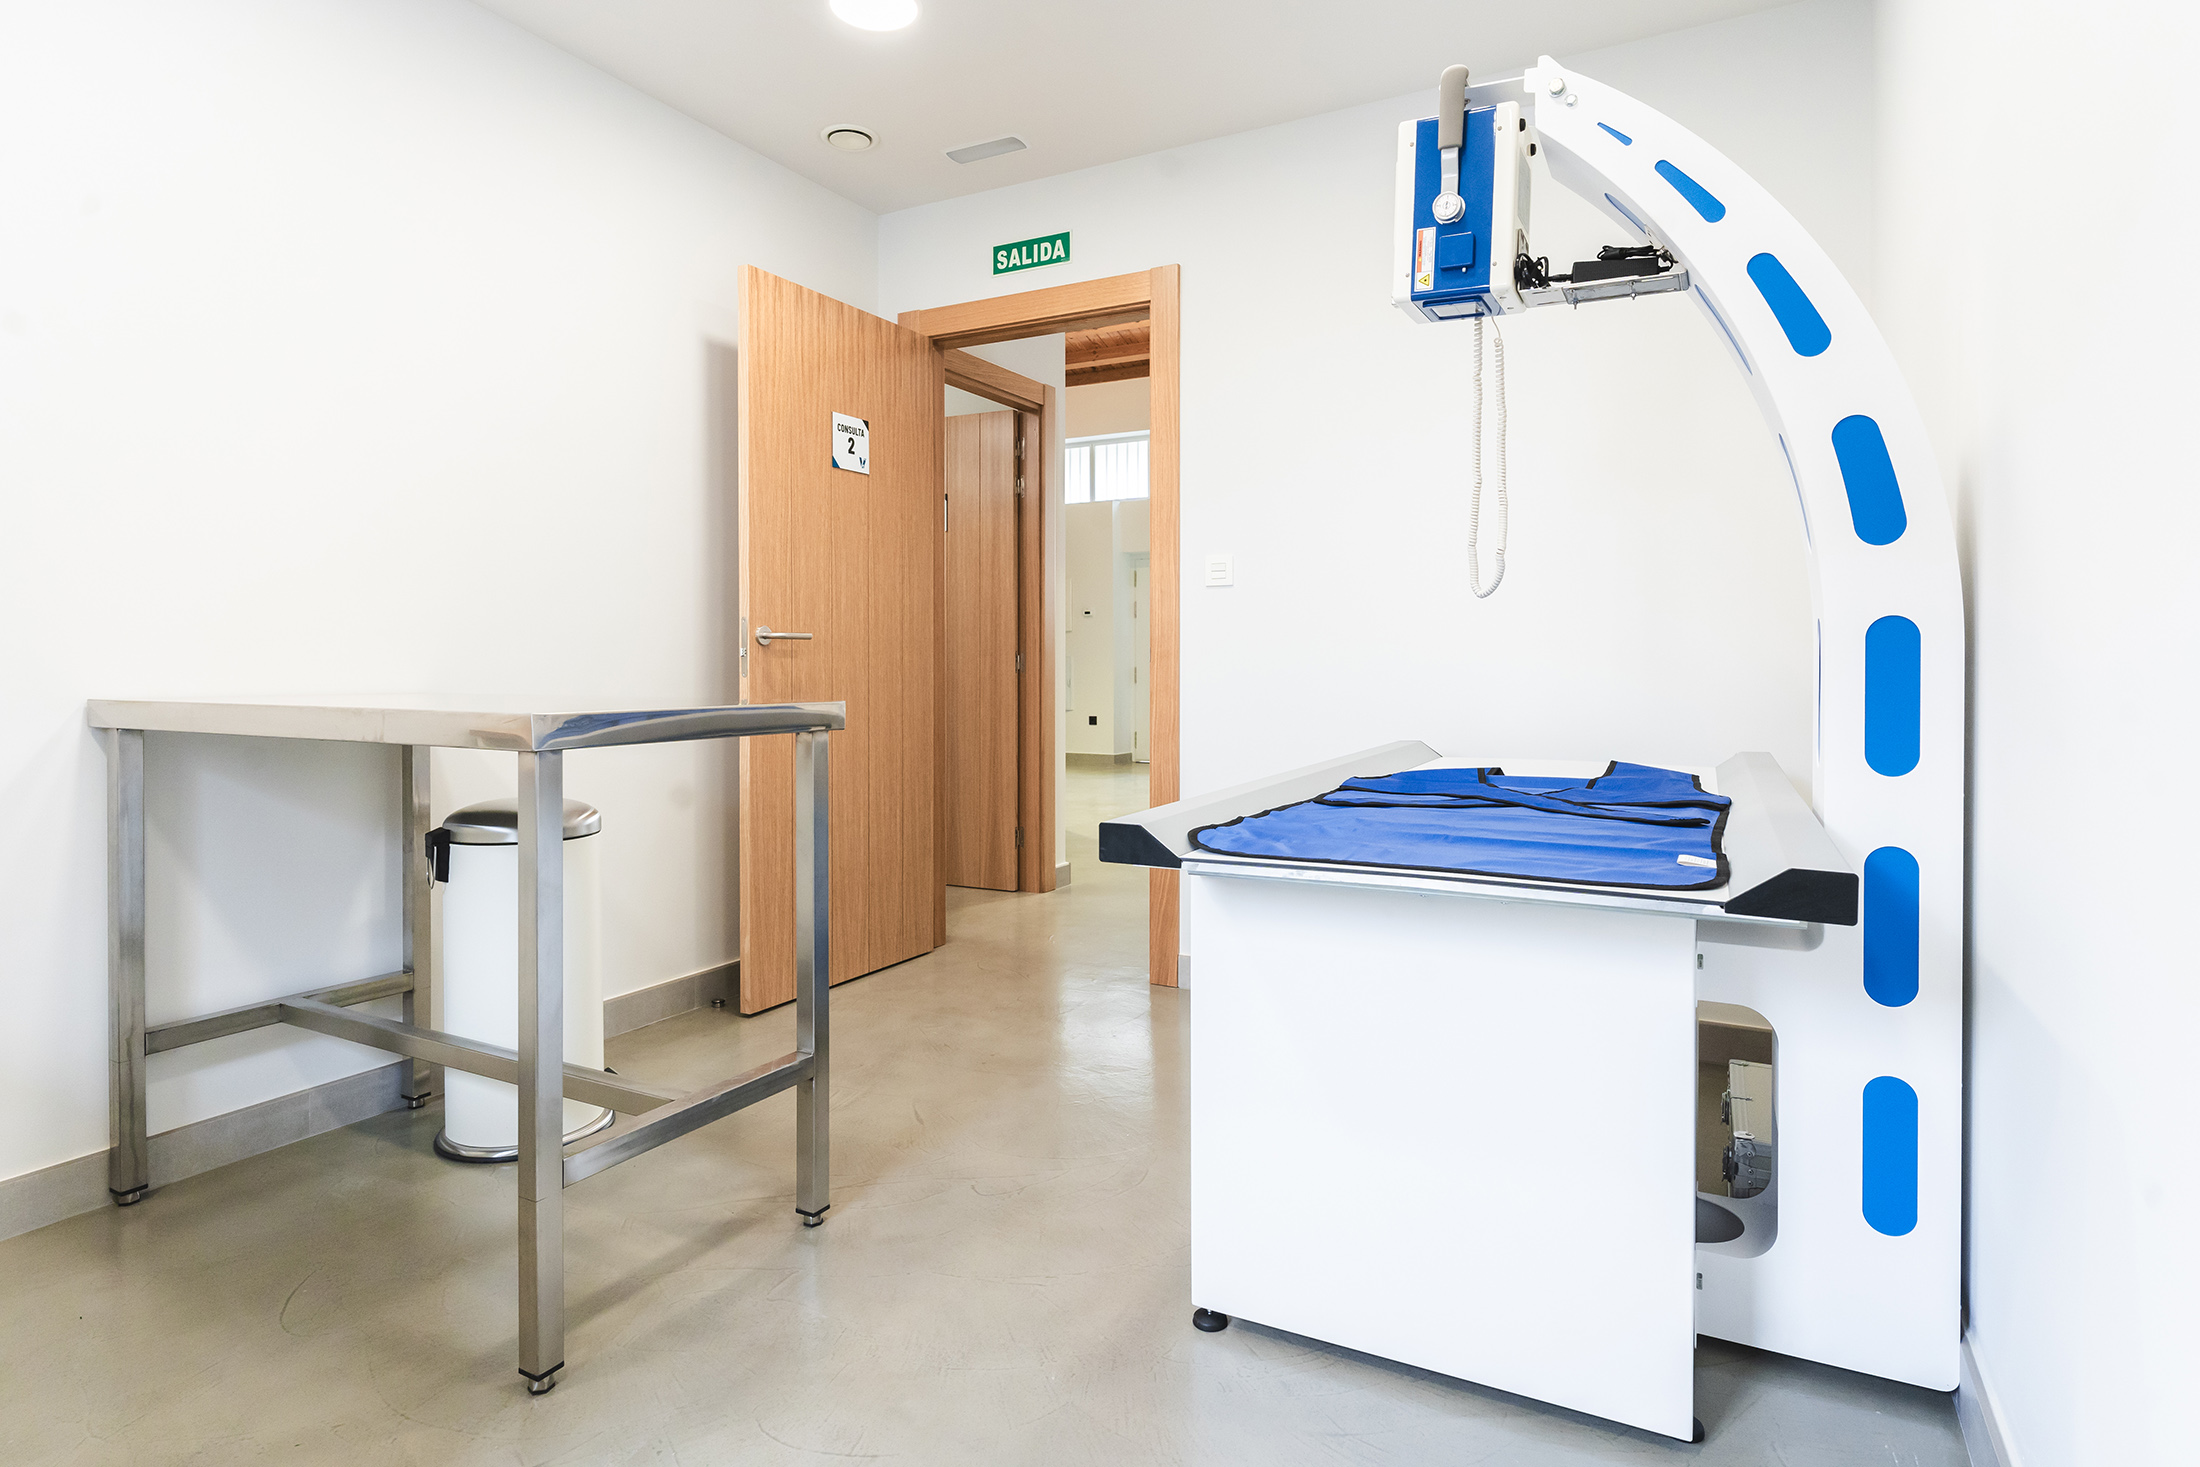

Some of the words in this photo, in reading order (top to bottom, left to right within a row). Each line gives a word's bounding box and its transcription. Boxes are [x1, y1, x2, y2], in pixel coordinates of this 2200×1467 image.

[996, 239, 1066, 270] SALIDA
[837, 423, 865, 438] CONSULTA
[847, 437, 855, 455] 2
